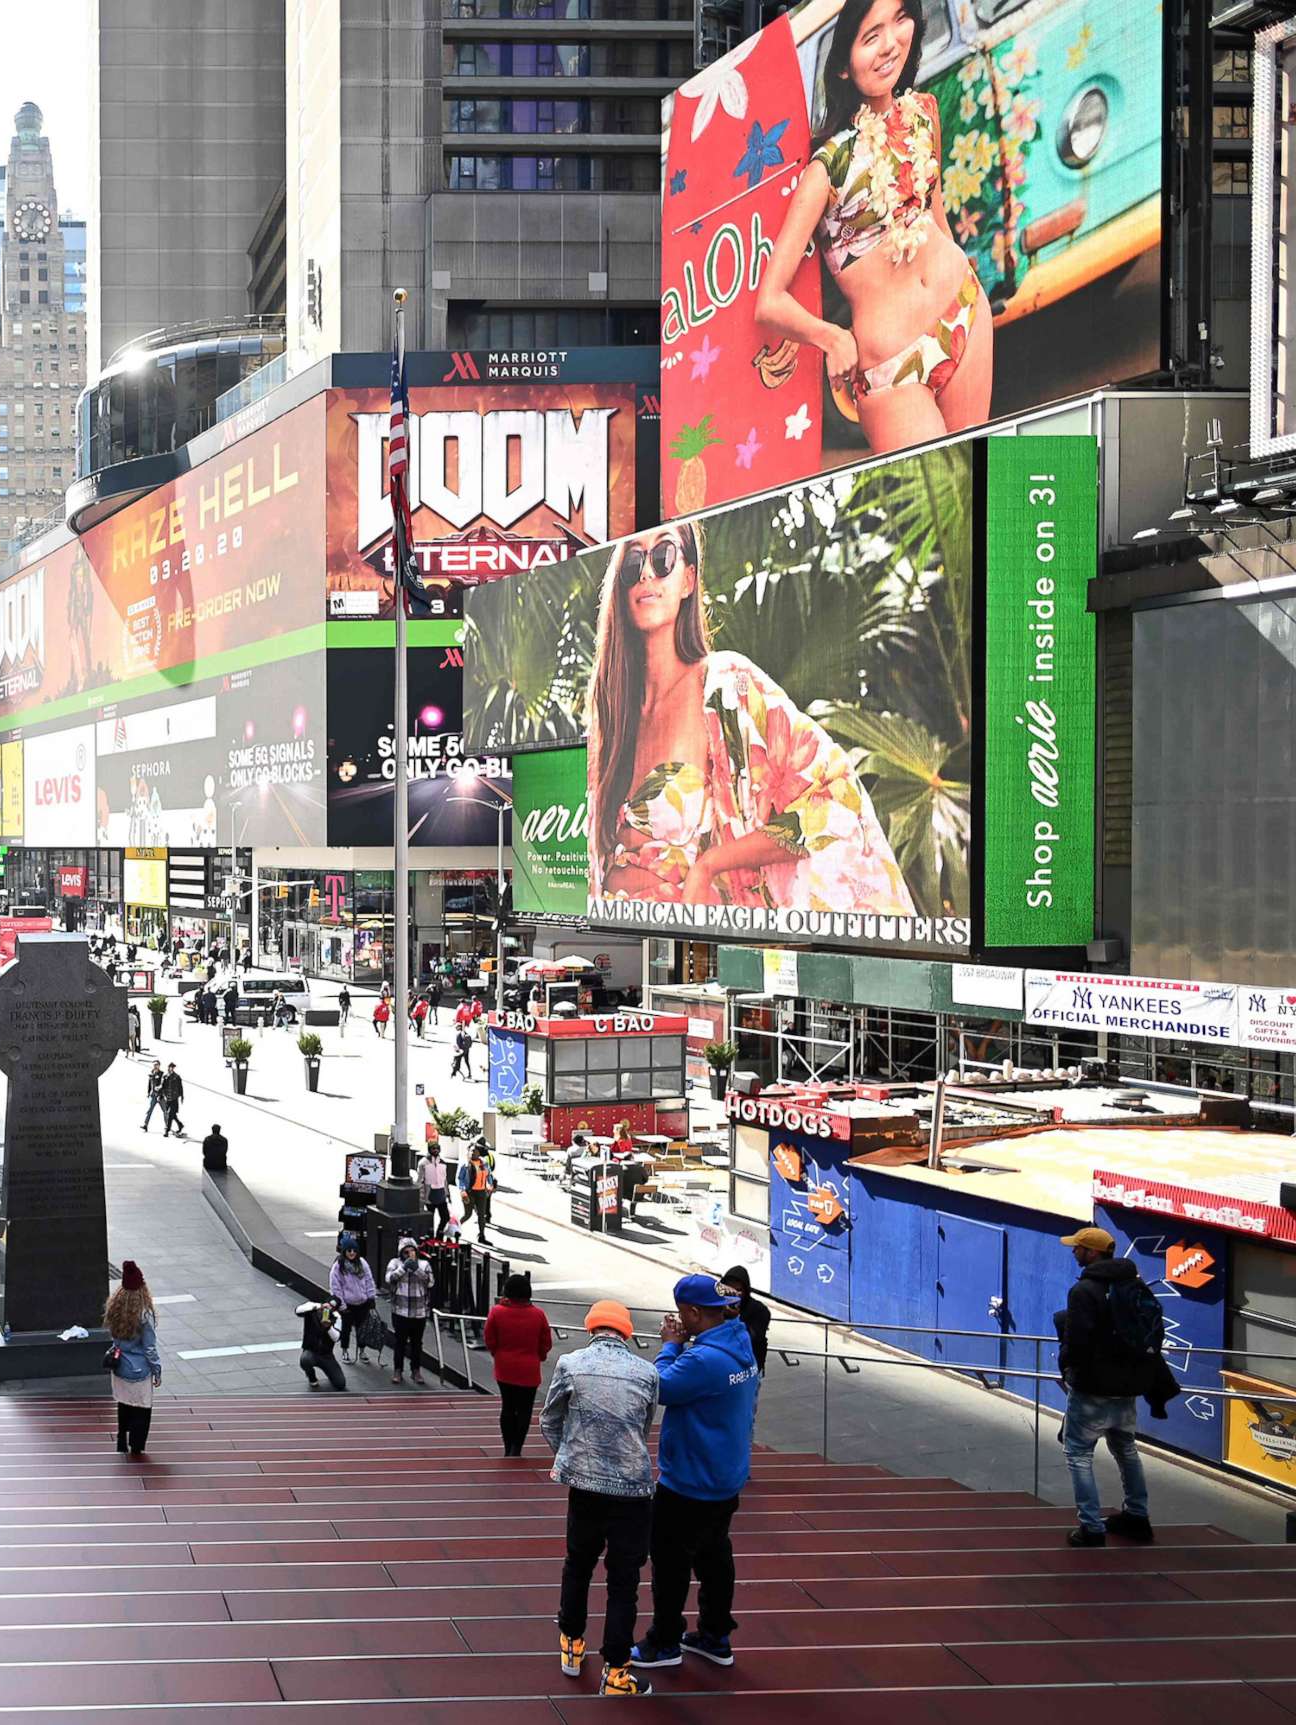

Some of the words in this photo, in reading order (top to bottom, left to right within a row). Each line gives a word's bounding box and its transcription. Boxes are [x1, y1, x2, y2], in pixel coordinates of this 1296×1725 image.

[488, 351, 568, 363] MARRIOTT
[488, 365, 559, 377] MARQUIS
[348, 408, 620, 553] DOOM
[1028, 474, 1057, 506] 3!
[112, 498, 187, 573] RAZE
[198, 442, 300, 530] HELL
[149, 526, 244, 586] 03.20.20
[1034, 520, 1055, 563] on
[167, 591, 243, 633] PRE-ORDER
[246, 572, 282, 606] NOW
[1027, 576, 1055, 683] inside
[228, 748, 254, 769] SOME
[255, 747, 269, 765] 5G
[269, 740, 315, 764] SIGNALS
[378, 735, 442, 757] SME
[1015, 698, 1059, 808] aerie
[131, 760, 171, 778] SEPHORA
[230, 768, 254, 788] ONLY
[527, 851, 554, 863] Power.
[531, 865, 543, 875] No
[1026, 821, 1060, 909] Shop
[207, 895, 241, 910] SEPHOA
[325, 875, 345, 921] T
[589, 900, 696, 925] AMERICAN
[705, 904, 778, 931] EAGLE
[785, 909, 969, 945] OUTFITTERS
[1098, 993, 1182, 1016] YANKEES
[495, 1010, 506, 1028] C
[507, 1013, 536, 1033] BAO
[594, 1016, 608, 1033] C
[613, 1014, 655, 1033] BAO
[1033, 1008, 1100, 1025] OFFICIAL
[1106, 1015, 1231, 1038] MERCHANDISE
[1249, 1019, 1294, 1029] DISCOUNT
[1255, 1027, 1279, 1036] GIFTS
[1247, 1035, 1296, 1045] SOUVENIRS
[726, 1096, 833, 1138] HOTDOGS
[1092, 1177, 1174, 1213] belgian
[1182, 1202, 1267, 1232] waffles
